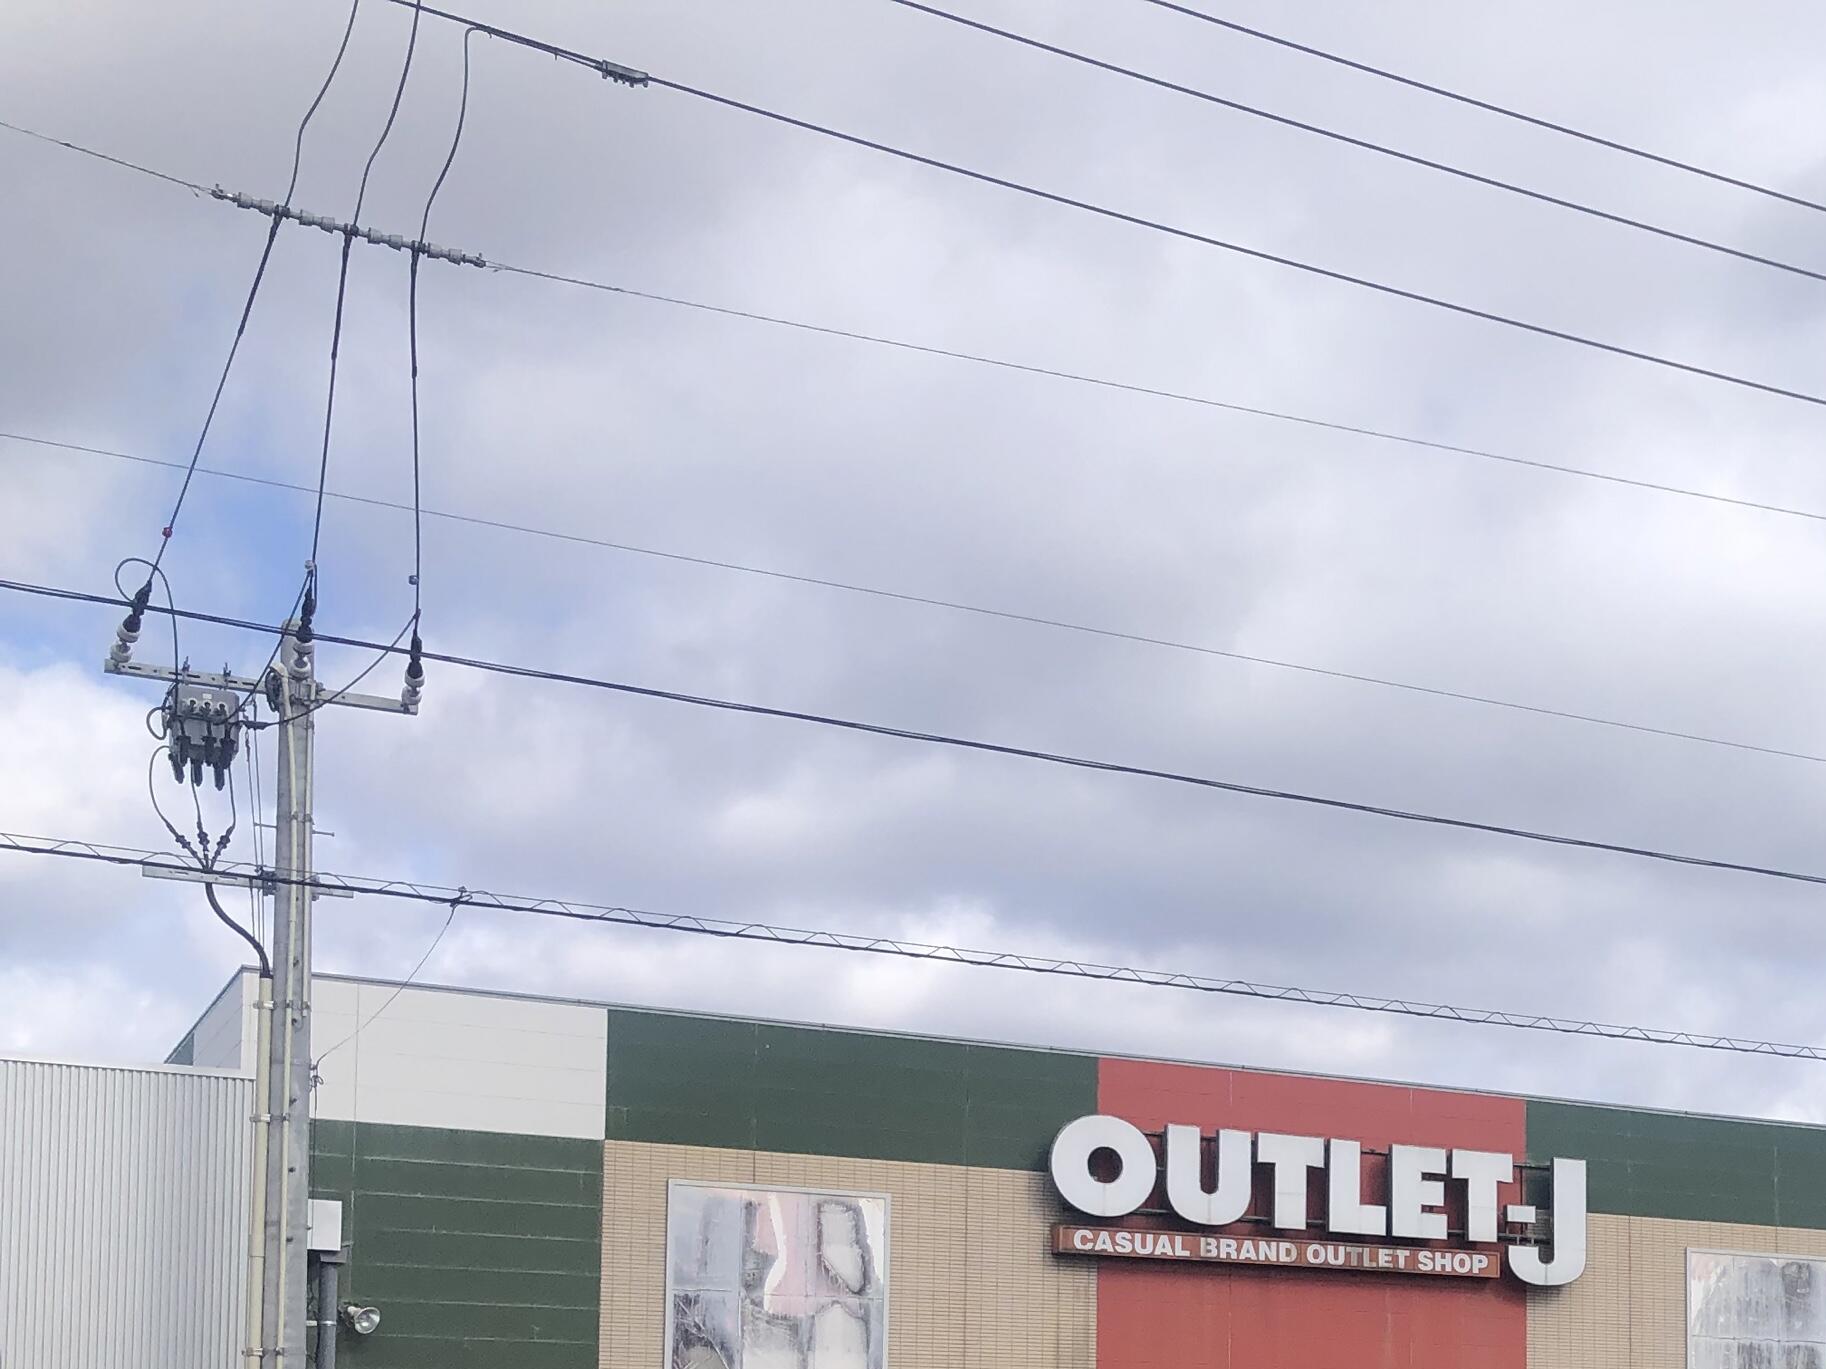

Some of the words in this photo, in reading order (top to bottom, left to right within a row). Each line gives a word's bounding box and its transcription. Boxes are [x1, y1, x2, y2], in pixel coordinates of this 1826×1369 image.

[1050, 1113, 1587, 1287] OUTLET-J
[1073, 1228, 1190, 1257] CASUAL
[1199, 1236, 1298, 1264] BRAND
[1306, 1243, 1410, 1271] OUTLET
[1417, 1250, 1489, 1276] SHOP
